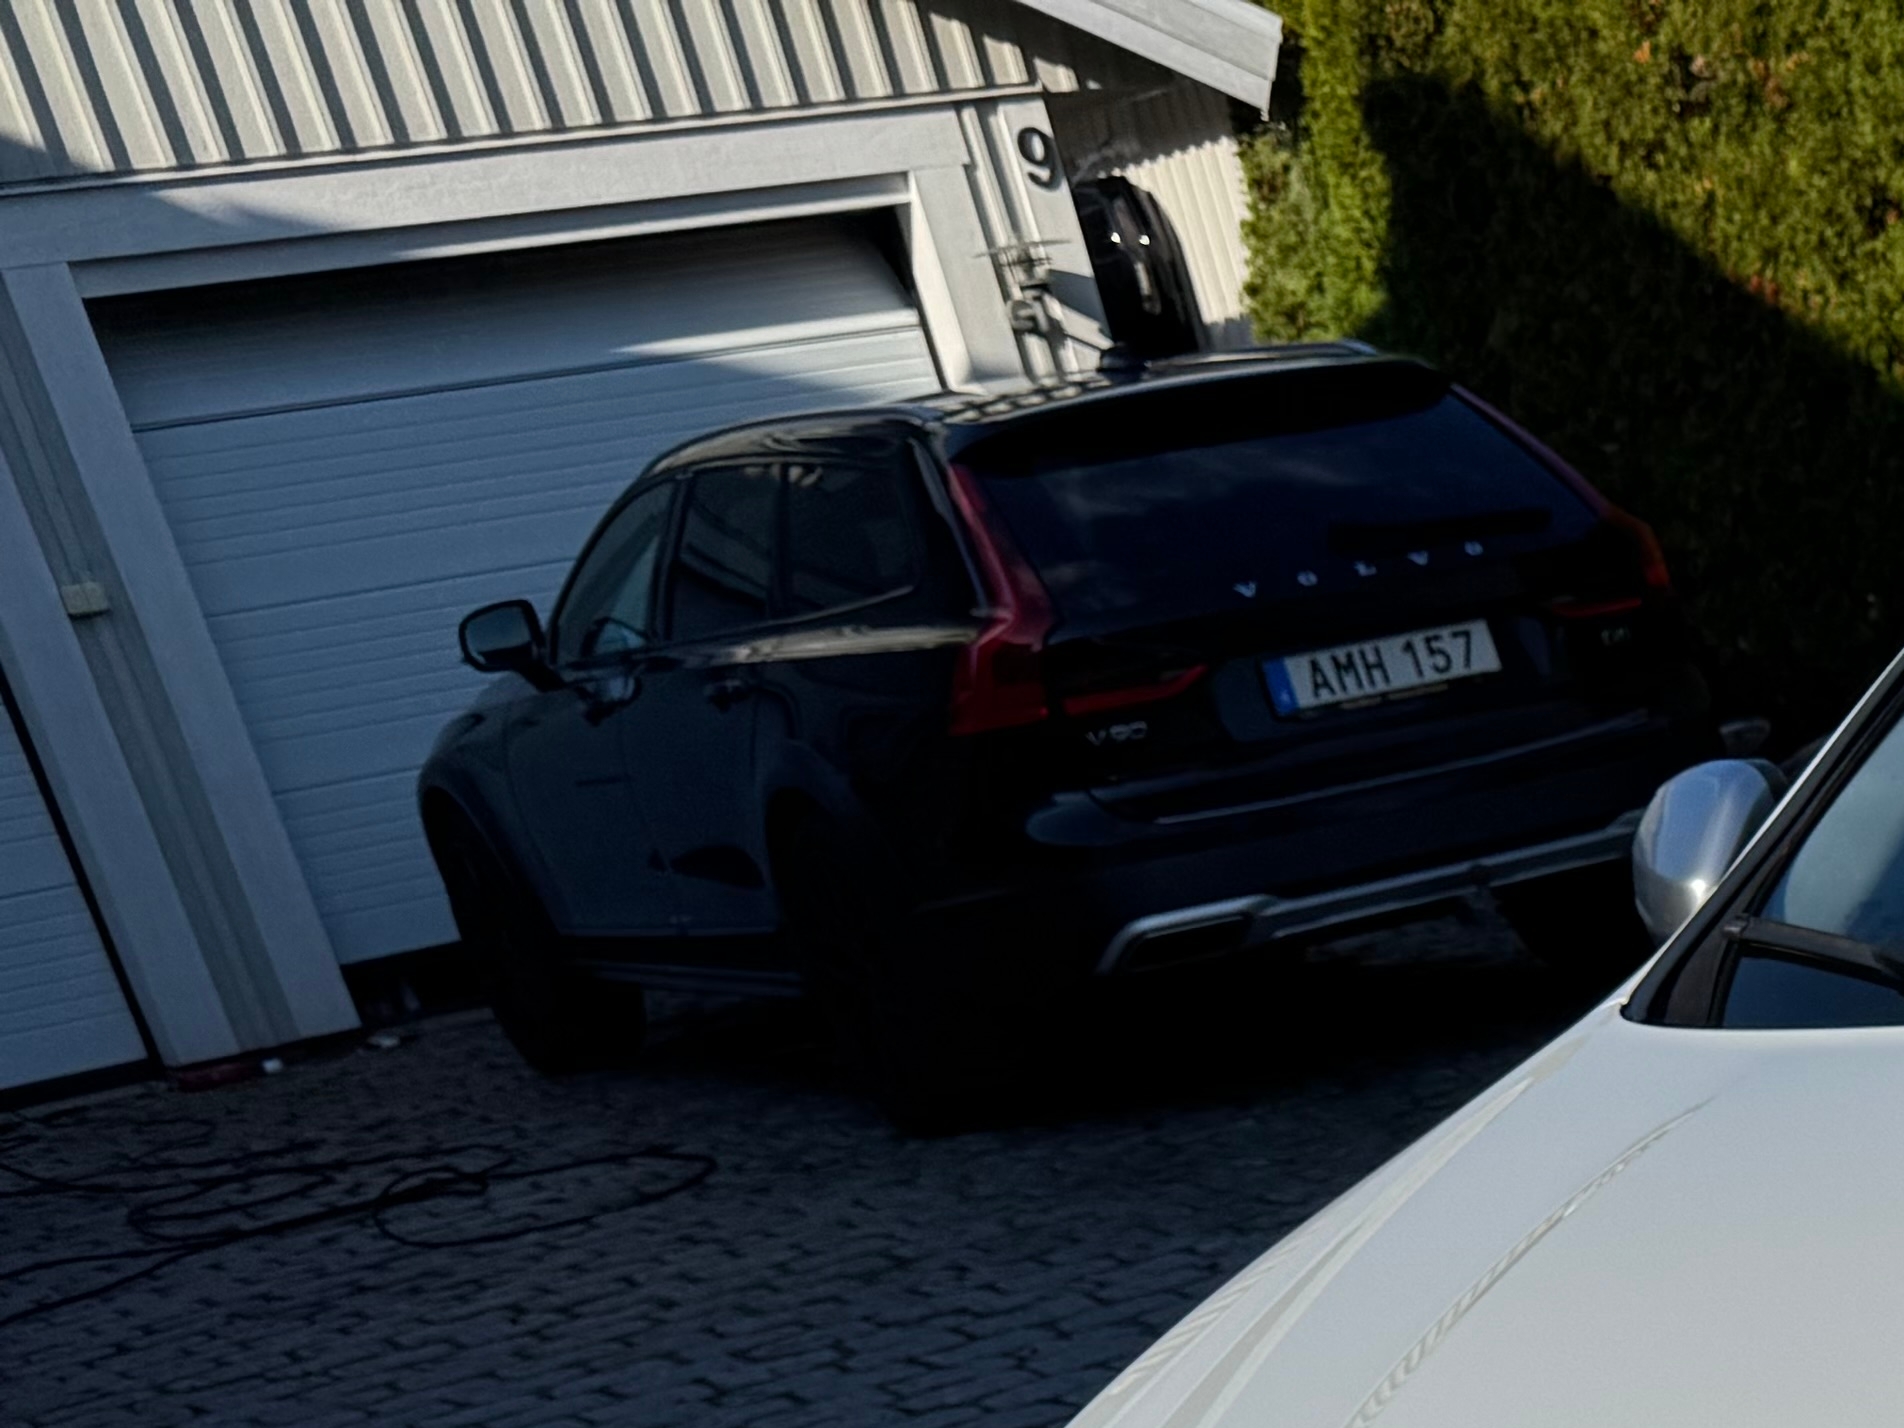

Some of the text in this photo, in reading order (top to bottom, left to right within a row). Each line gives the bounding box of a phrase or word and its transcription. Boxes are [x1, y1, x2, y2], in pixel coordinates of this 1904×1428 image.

[1017, 126, 1061, 192] 9
[1233, 541, 1484, 598] VOLVO
[1309, 629, 1473, 699] AMH 157
